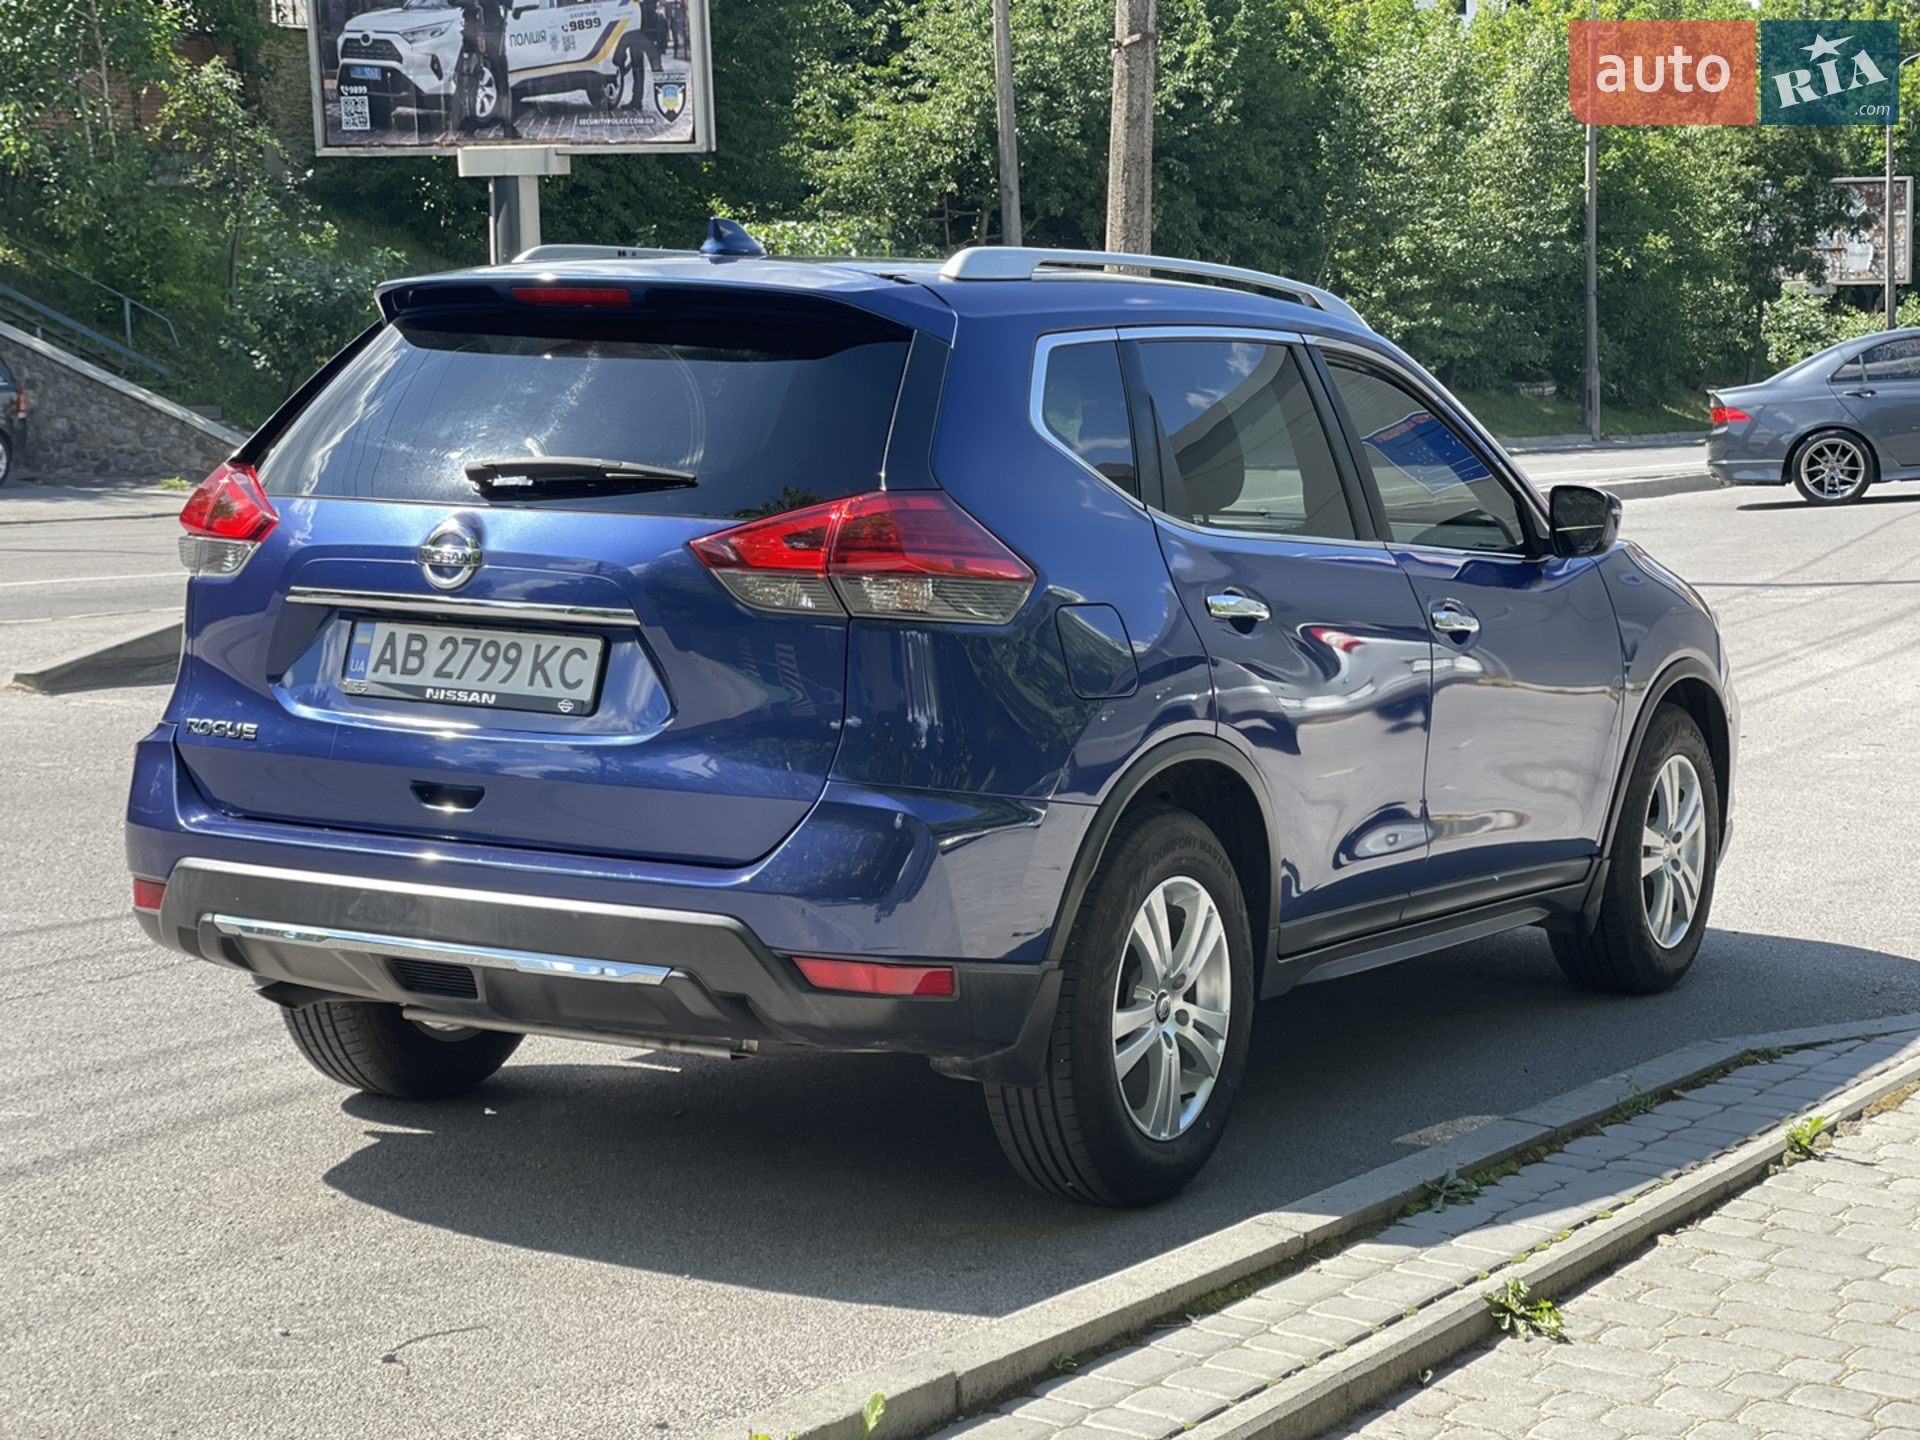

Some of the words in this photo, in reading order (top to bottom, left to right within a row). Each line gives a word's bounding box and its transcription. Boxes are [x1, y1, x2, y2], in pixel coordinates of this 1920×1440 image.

[569, 17, 602, 32] 9899
[420, 548, 473, 564] NISSAN
[350, 659, 366, 673] UA
[371, 631, 429, 676] AB
[433, 636, 522, 685] 2799
[527, 644, 589, 690] KC
[425, 688, 496, 705] NISSAN
[186, 717, 259, 740] ROGUE
[1151, 836, 1198, 866] COMFORT
